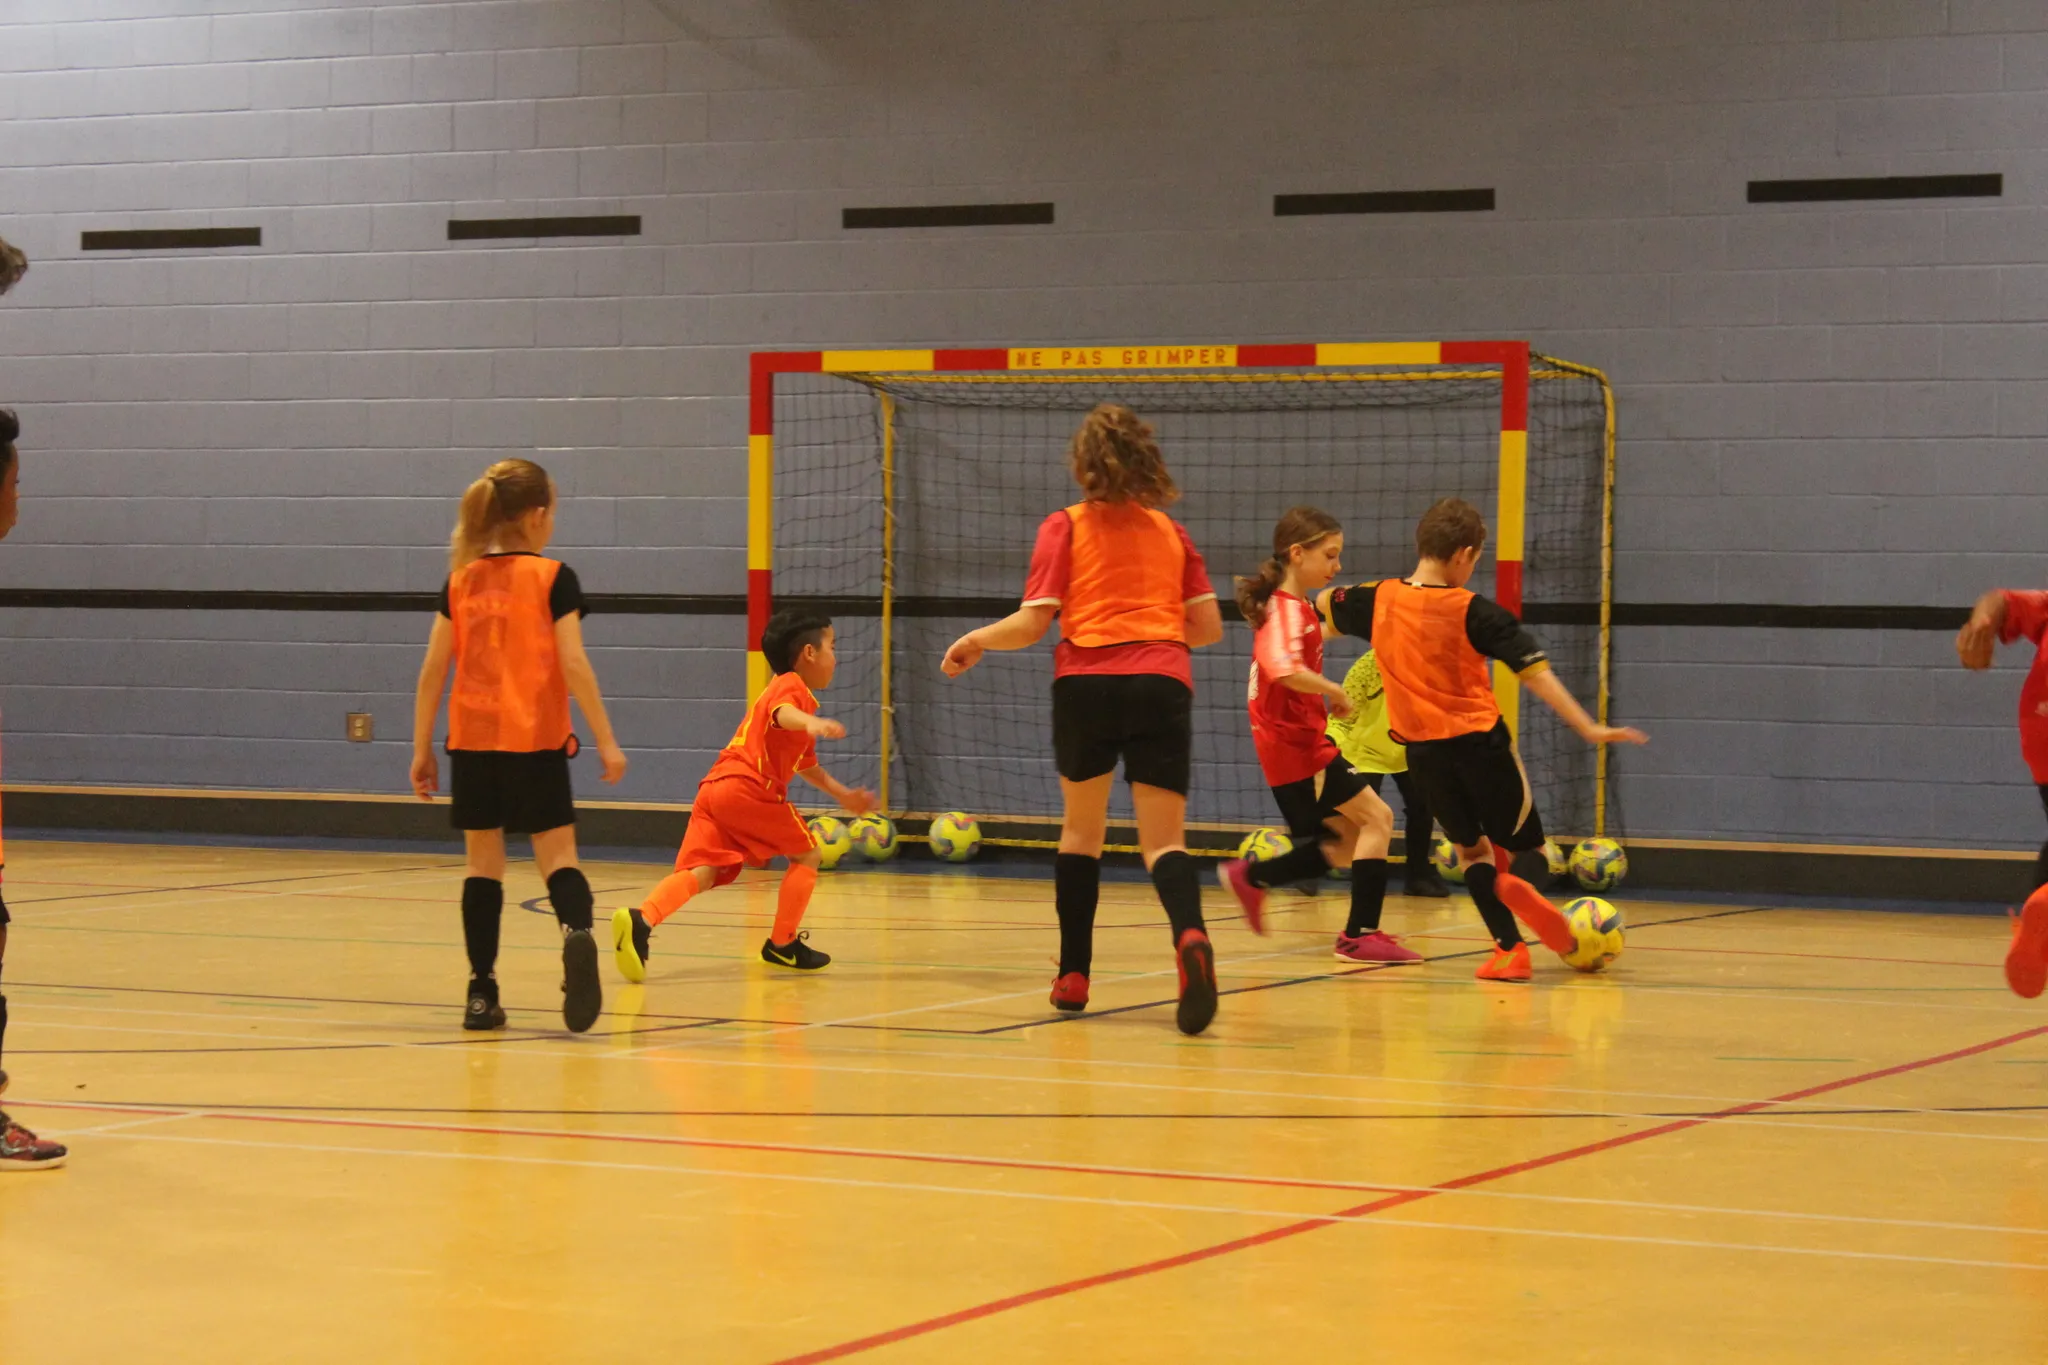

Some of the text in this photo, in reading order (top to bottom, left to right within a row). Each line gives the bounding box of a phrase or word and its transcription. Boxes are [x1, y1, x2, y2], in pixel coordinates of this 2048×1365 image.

[1016, 348, 1227, 367] NE PAS GRIMPER
